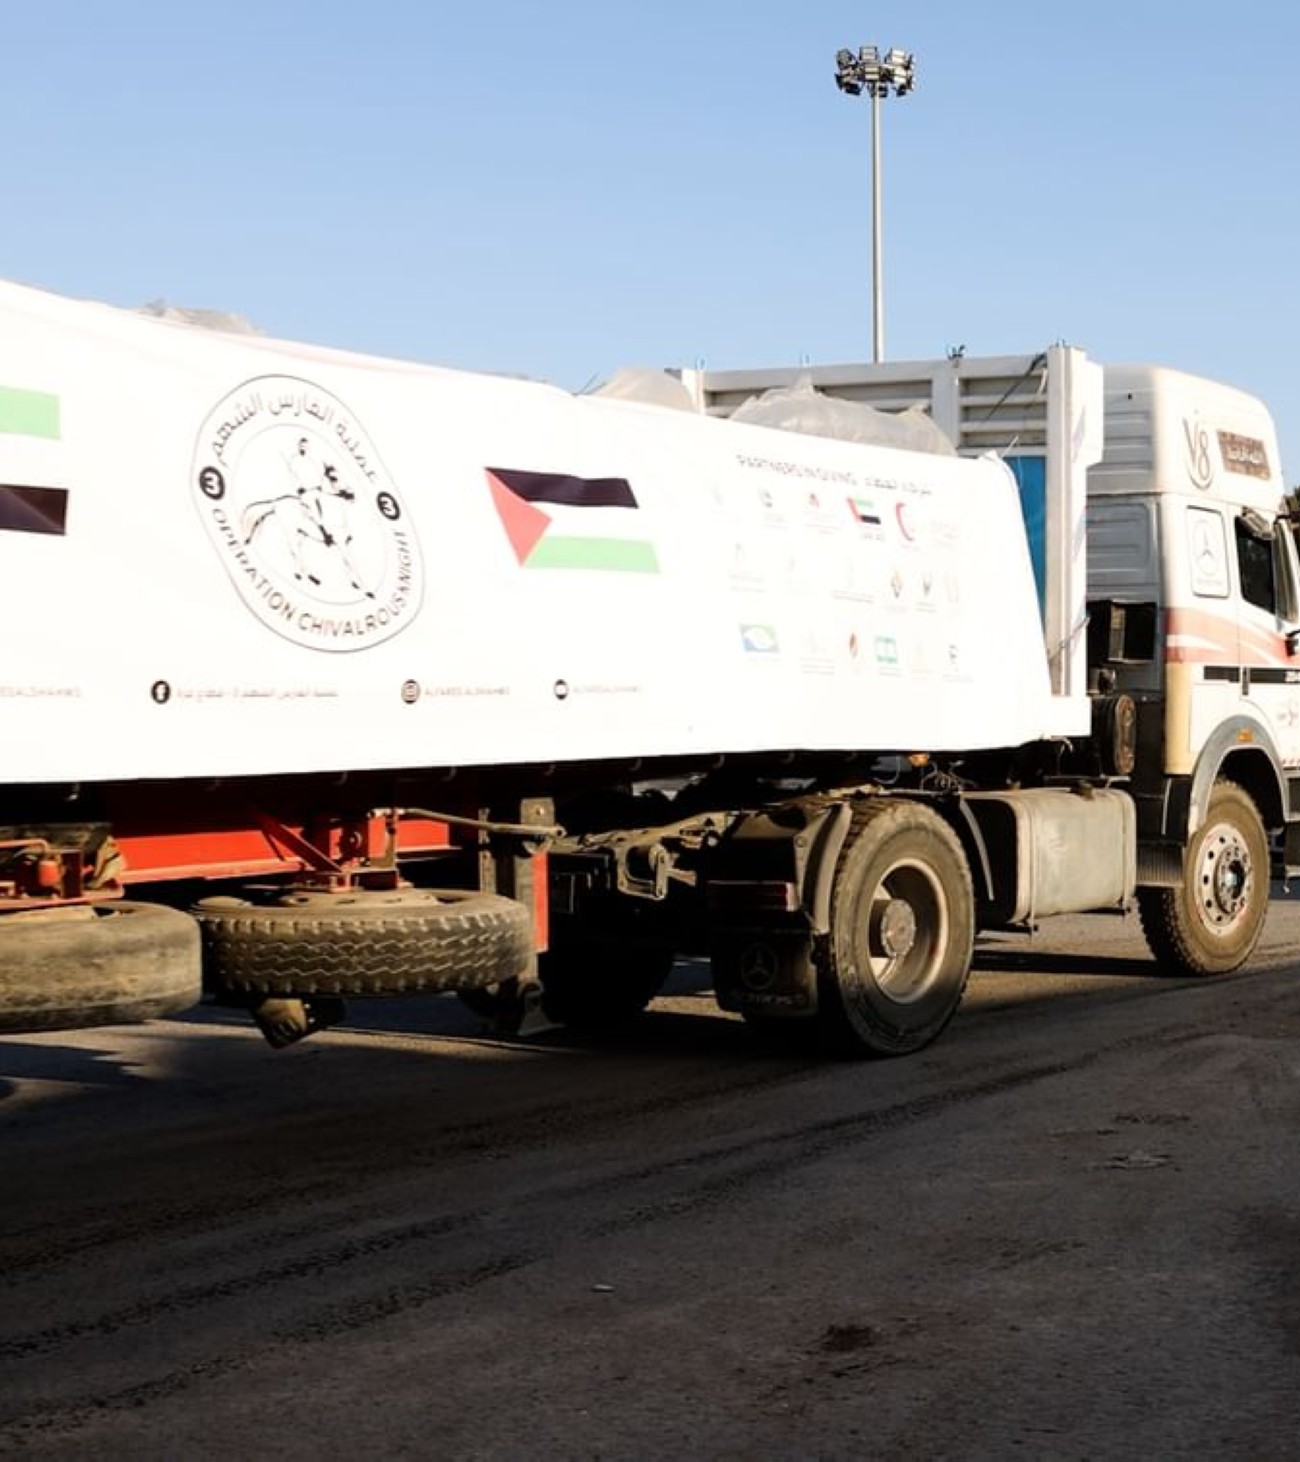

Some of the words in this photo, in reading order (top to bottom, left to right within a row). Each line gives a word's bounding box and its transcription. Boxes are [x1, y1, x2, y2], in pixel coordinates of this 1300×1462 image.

[211, 392, 263, 467] الشهم
[268, 393, 335, 424] الفارس
[1183, 417, 1210, 481] V8
[212, 507, 297, 622] OPERATION
